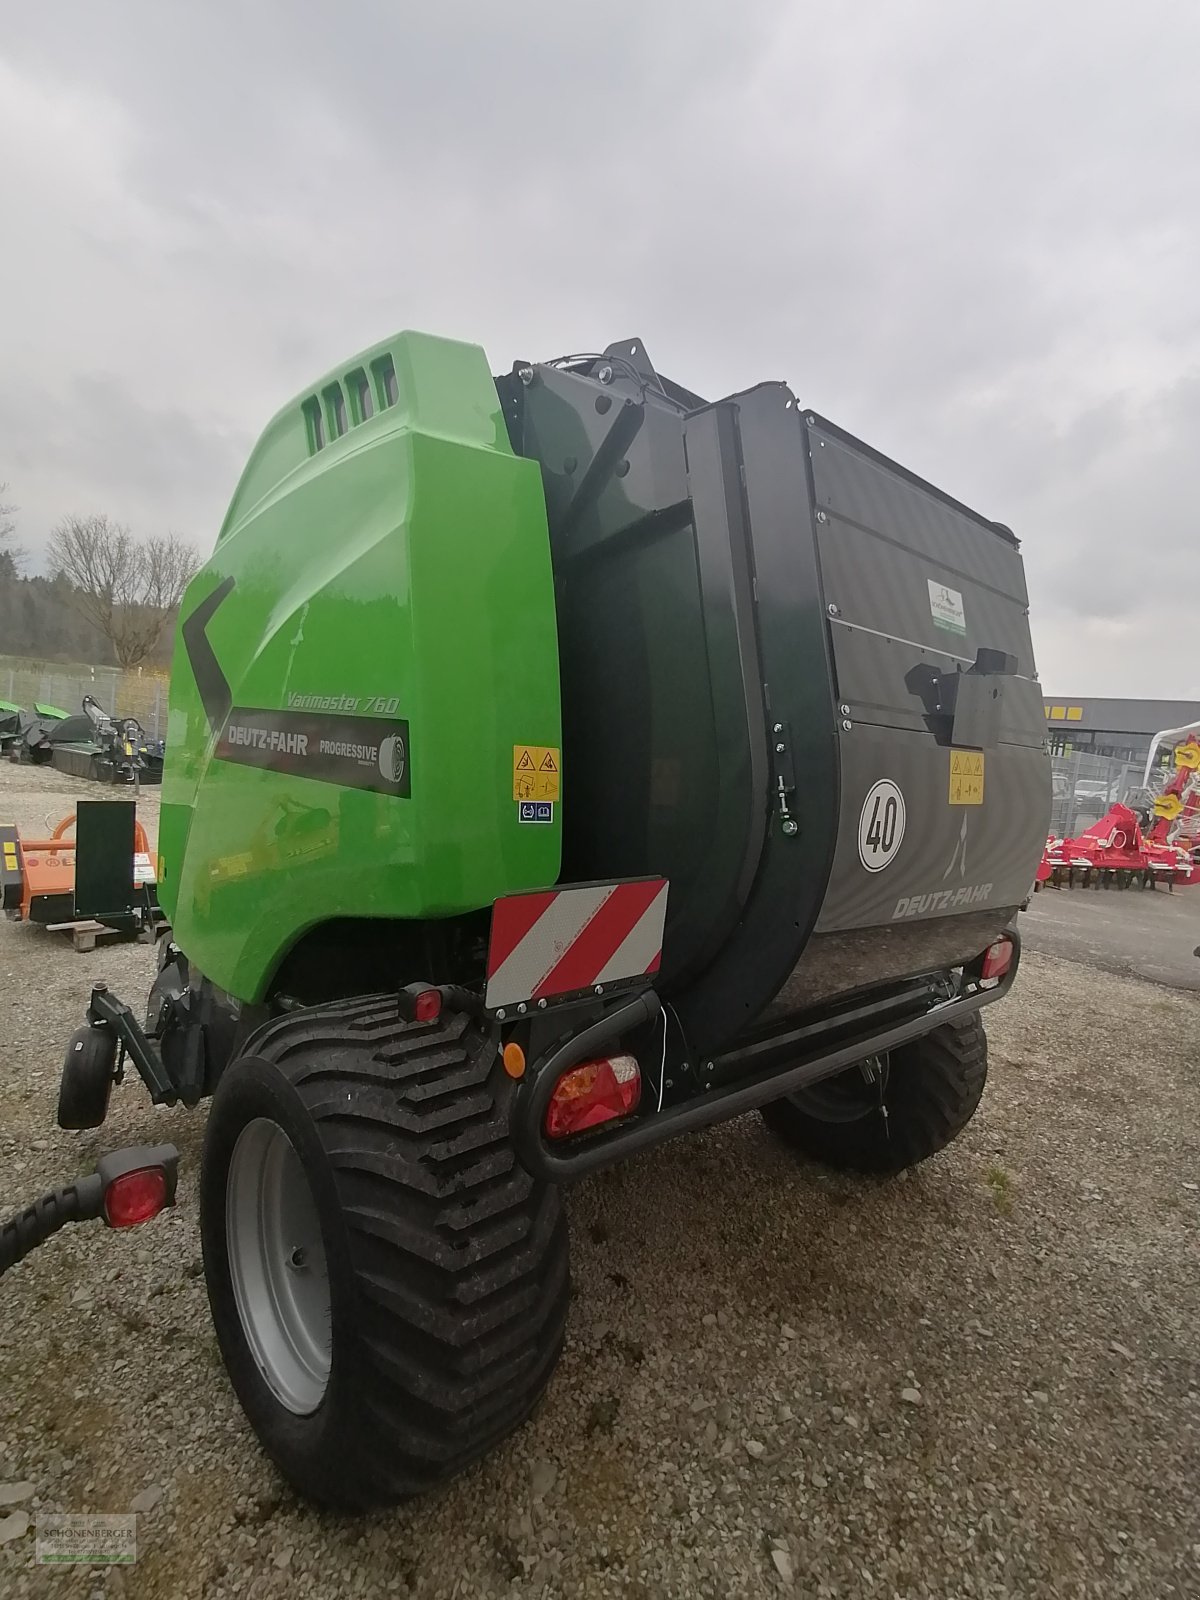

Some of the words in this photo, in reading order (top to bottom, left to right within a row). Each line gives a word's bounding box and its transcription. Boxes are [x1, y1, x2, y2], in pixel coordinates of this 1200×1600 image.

[287, 691, 361, 711] Varimaster
[363, 697, 400, 714] 760
[228, 725, 308, 755] DEUTZ-FAHR
[319, 740, 378, 761] PROGRESSIVE
[866, 796, 897, 853] 40
[892, 883, 993, 919] DEUTZ-FAHR
